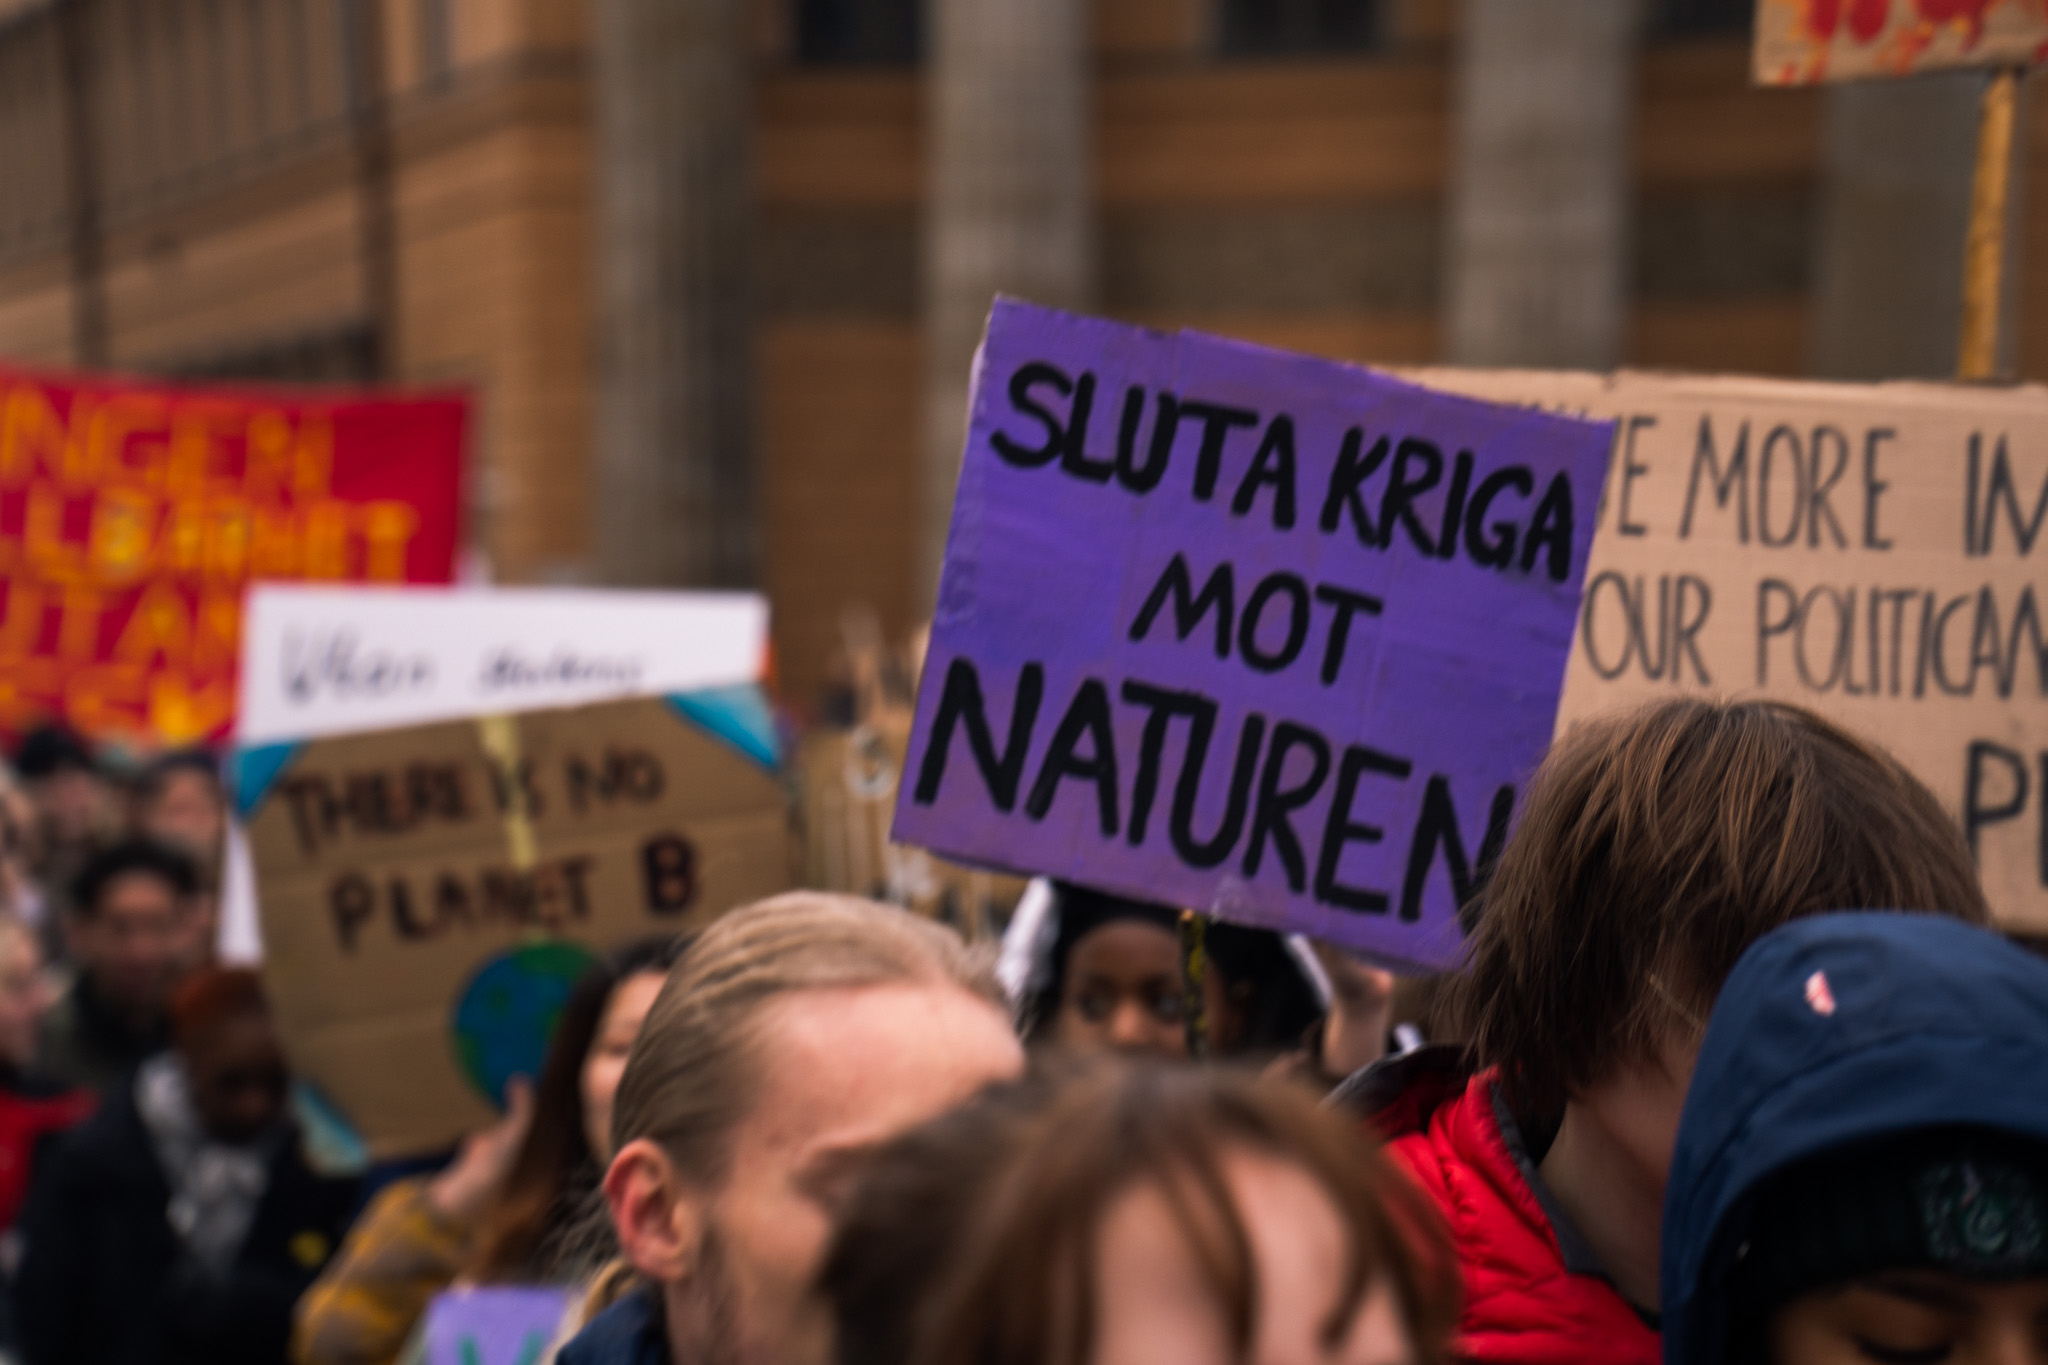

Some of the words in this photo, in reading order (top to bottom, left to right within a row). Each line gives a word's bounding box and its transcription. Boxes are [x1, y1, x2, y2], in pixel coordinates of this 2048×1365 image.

[990, 361, 1297, 531] SLUTA
[1319, 426, 1576, 584] KRIGA
[1679, 413, 1897, 549] MORE
[1127, 551, 1384, 688] MOT
[1583, 570, 1714, 687] OUR
[280, 760, 470, 858] THERE
[566, 744, 667, 815] NO
[912, 656, 1518, 939] NATUREN
[327, 853, 594, 954] PLANET
[643, 830, 699, 918] B
